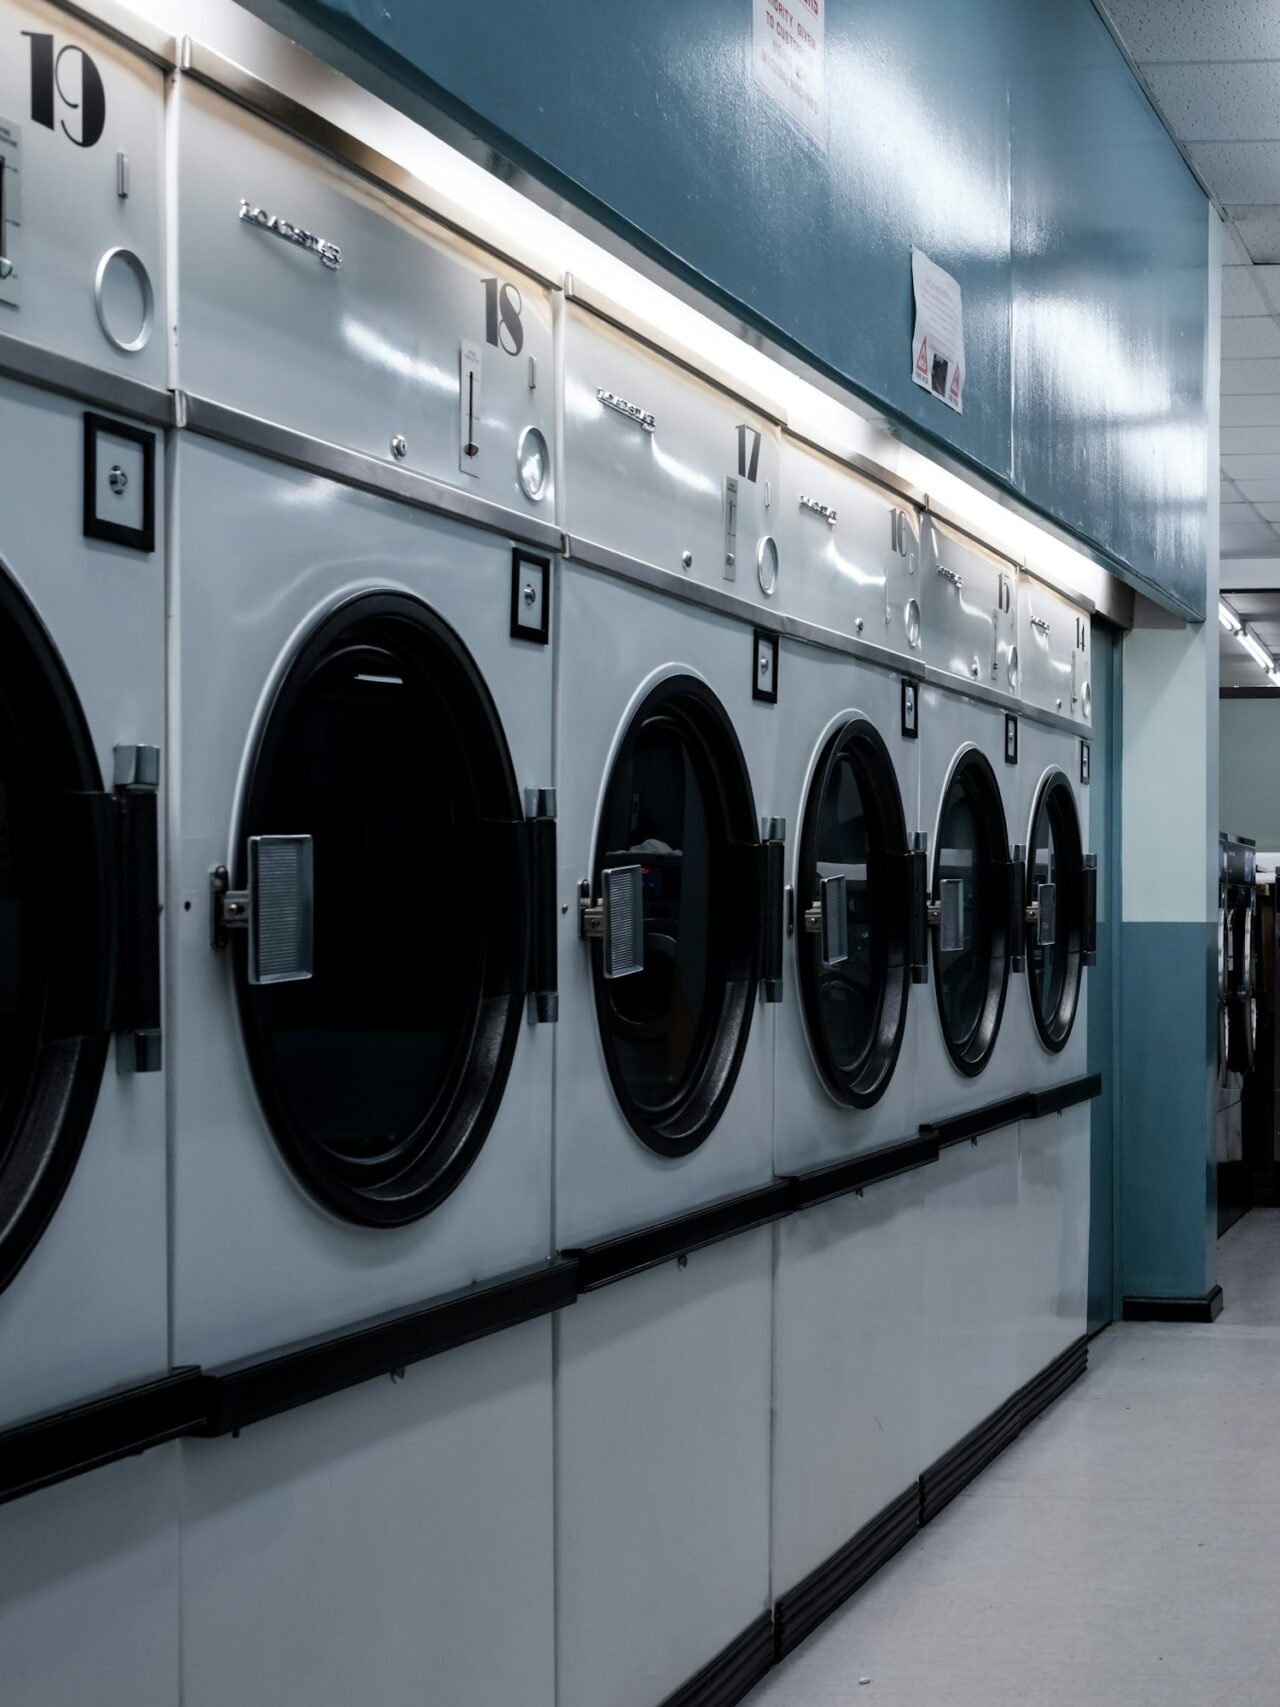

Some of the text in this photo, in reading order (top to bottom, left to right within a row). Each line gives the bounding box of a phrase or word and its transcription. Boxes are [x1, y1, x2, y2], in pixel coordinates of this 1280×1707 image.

[766, 10, 774, 29] TO
[797, 22, 816, 50] GIVEN
[20, 31, 106, 147] 19
[480, 277, 524, 356] 18
[735, 423, 761, 483] 17
[889, 508, 908, 557] 16
[997, 572, 1010, 614] 15
[1076, 617, 1085, 652] 14
